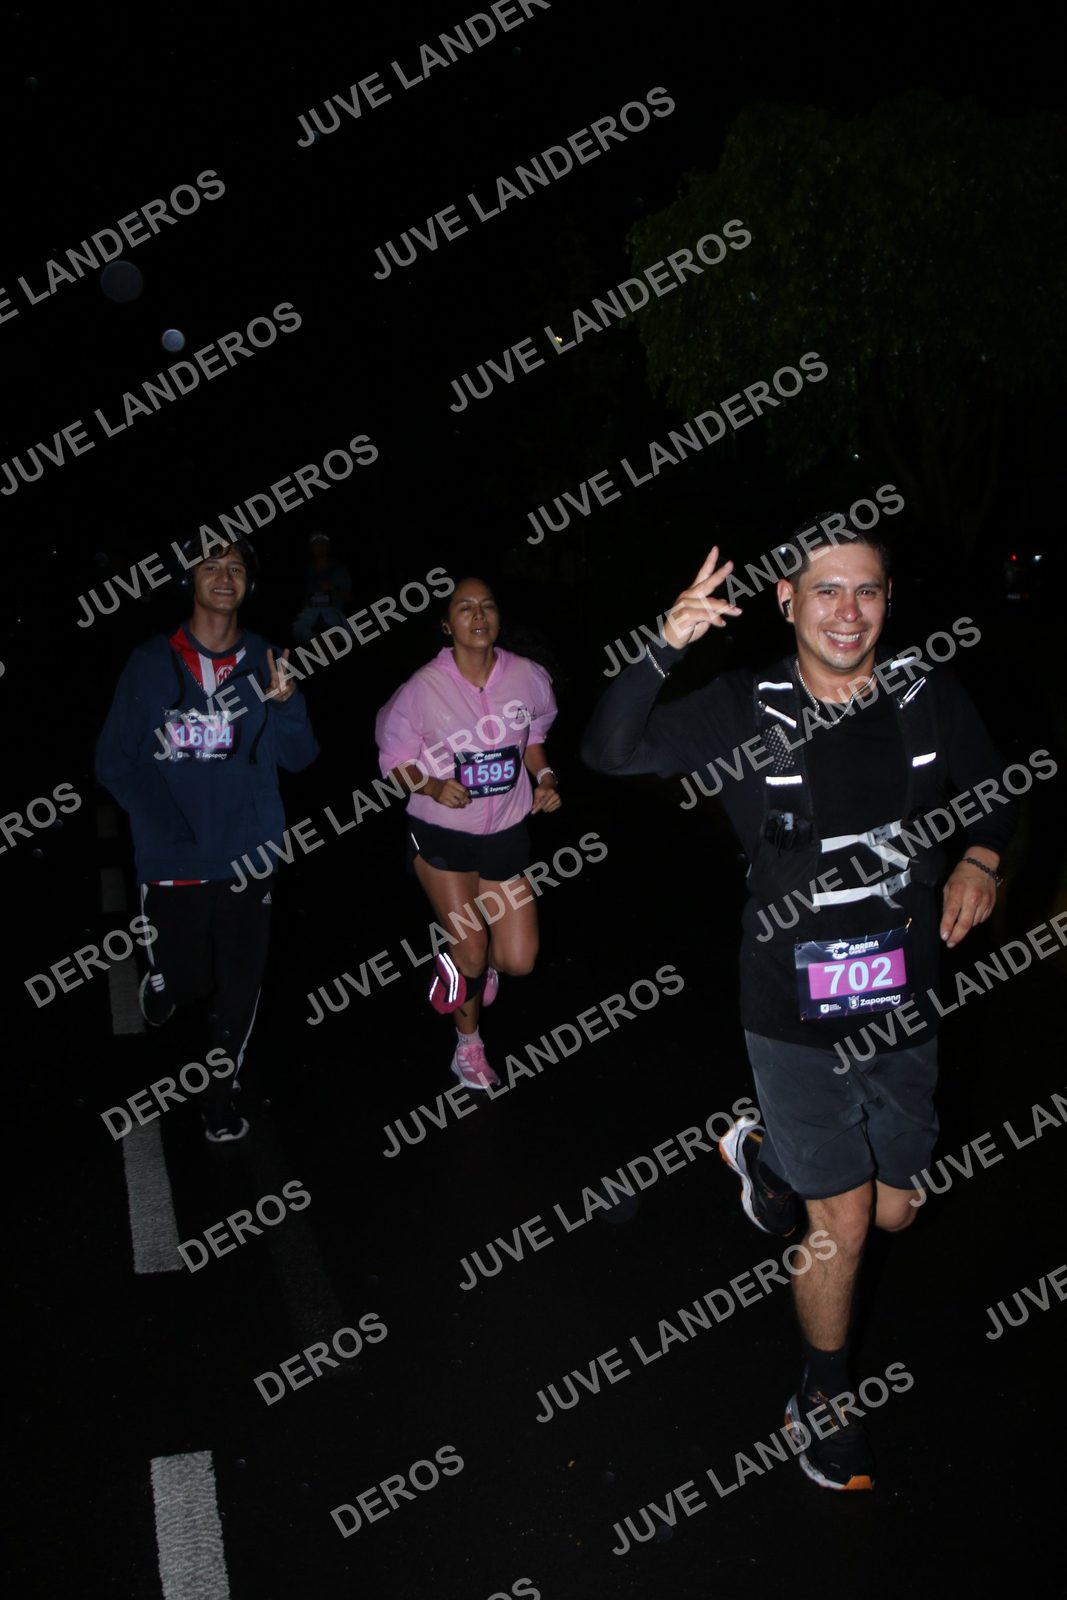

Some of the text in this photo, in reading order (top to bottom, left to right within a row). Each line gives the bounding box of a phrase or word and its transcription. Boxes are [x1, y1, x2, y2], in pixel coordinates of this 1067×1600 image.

[176, 726, 232, 747] 1604
[464, 759, 515, 785] 1595
[824, 956, 893, 994] 702
